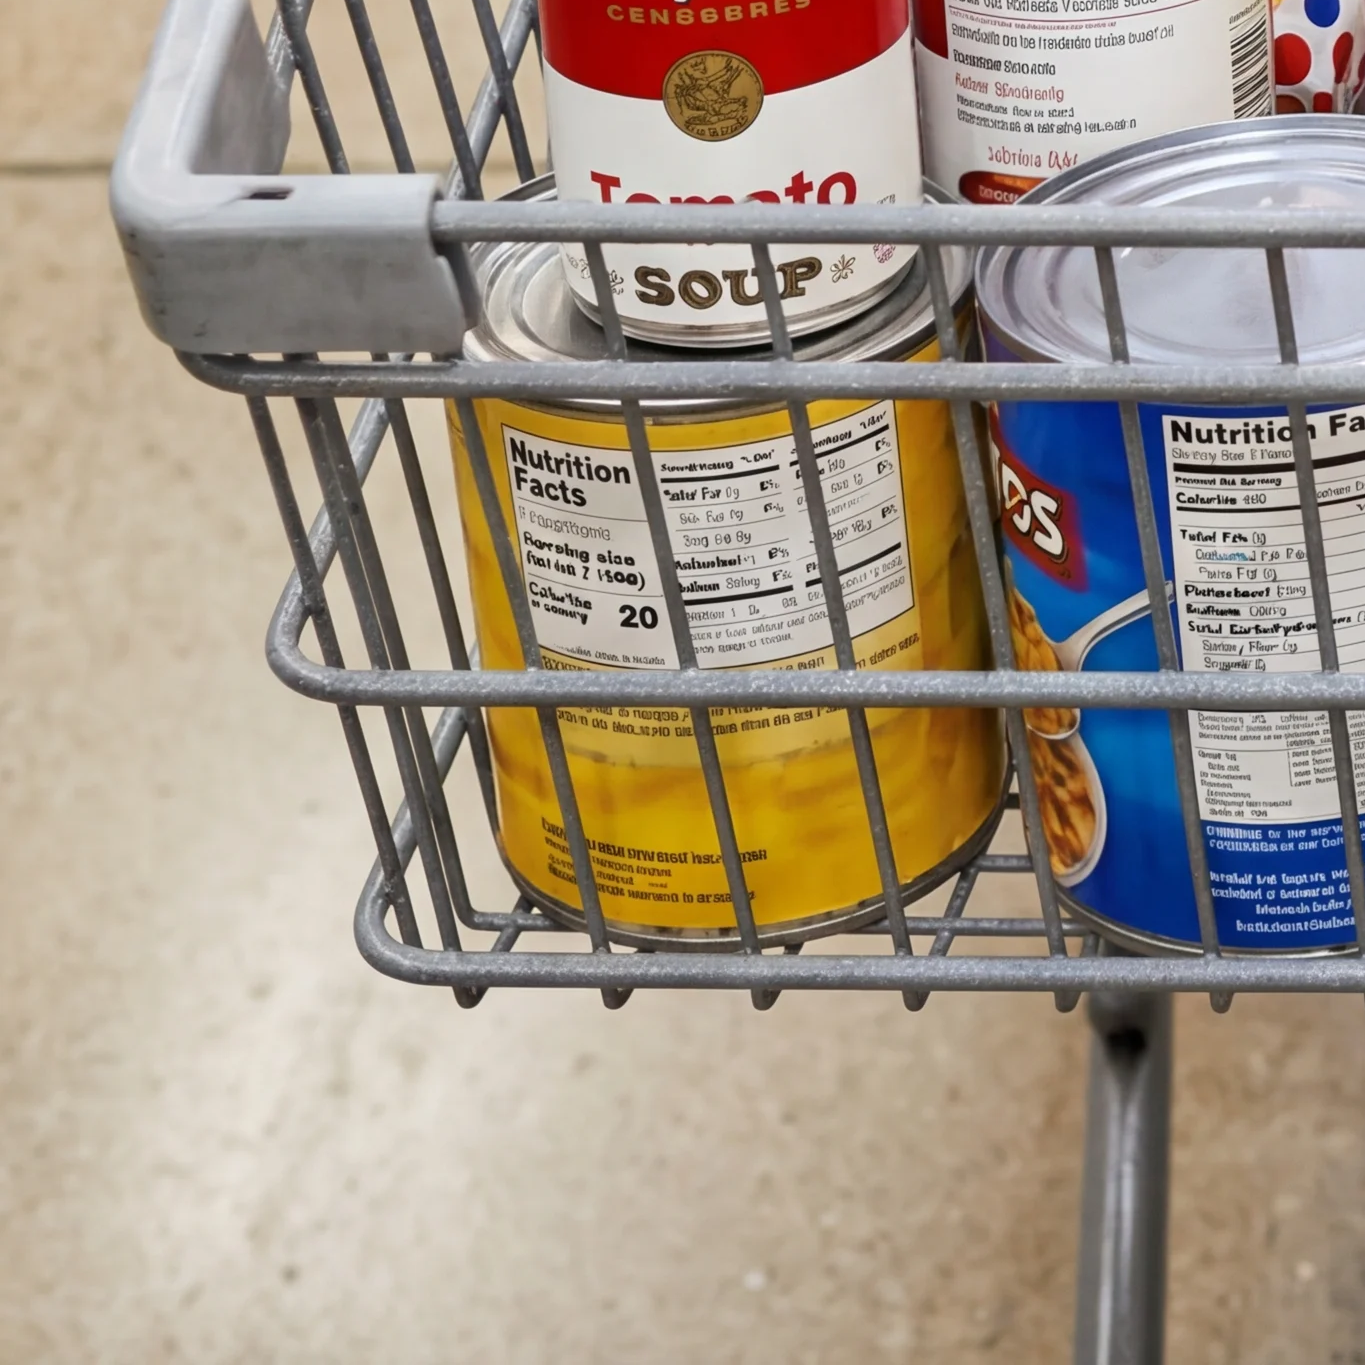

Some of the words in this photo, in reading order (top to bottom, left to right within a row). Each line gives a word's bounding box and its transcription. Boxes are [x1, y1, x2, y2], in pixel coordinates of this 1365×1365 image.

[633, 256, 823, 311] SOUP
[509, 436, 632, 486] Nutrition
[514, 465, 588, 508] Facts
[618, 603, 659, 630] 20
